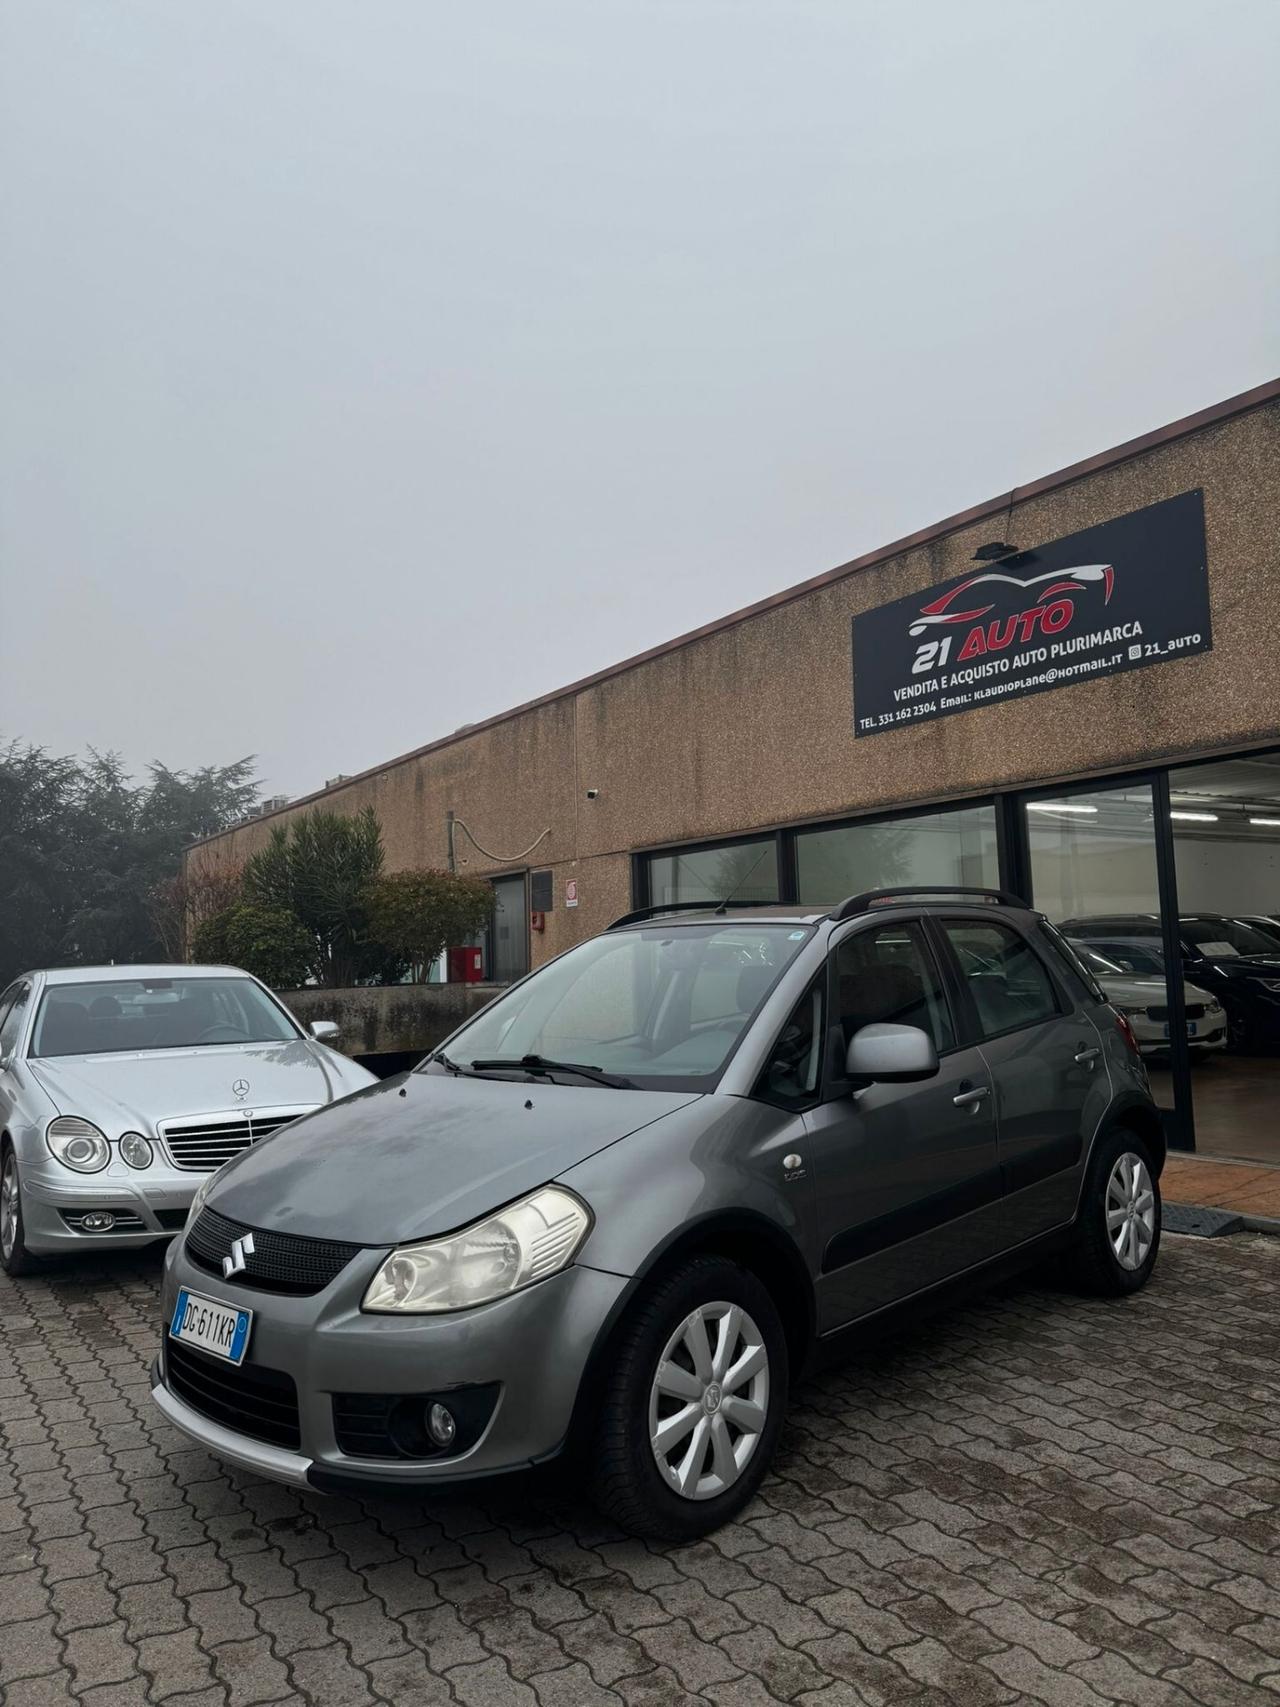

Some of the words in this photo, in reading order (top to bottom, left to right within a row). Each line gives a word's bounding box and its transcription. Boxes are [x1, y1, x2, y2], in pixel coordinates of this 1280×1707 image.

[893, 679, 939, 702] VENDITA
[941, 676, 948, 689] E
[950, 659, 1010, 684] ACQUISTO
[1012, 647, 1048, 670] AUTO
[1051, 620, 1144, 659] PLURIMARCA
[911, 635, 953, 675] 21
[957, 598, 1075, 662] AUTO
[860, 717, 878, 730] TEL.
[878, 713, 894, 726] 331
[896, 707, 912, 721] 162
[913, 701, 937, 717] 2304
